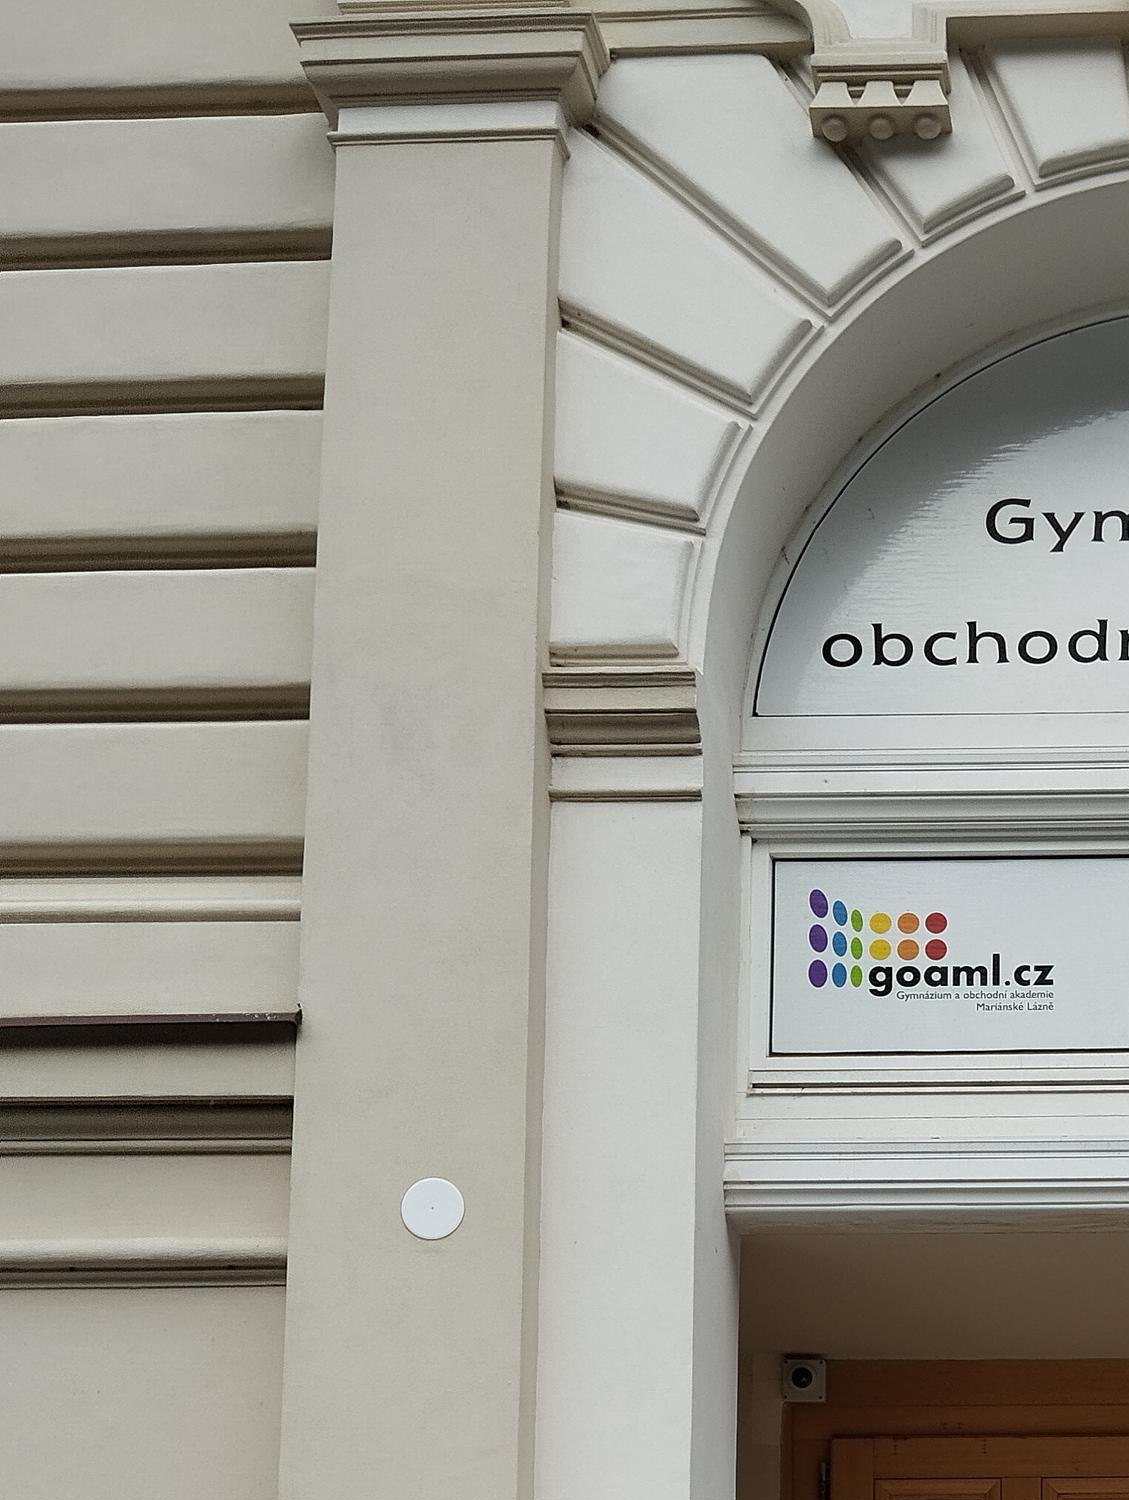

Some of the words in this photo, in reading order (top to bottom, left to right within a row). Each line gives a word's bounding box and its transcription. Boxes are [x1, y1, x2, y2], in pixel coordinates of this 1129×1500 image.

[868, 953, 1054, 997] goaml.cz
[896, 990, 952, 1002] Gymnázium
[963, 990, 1007, 999] obchodní
[1010, 990, 1054, 999] akademie
[976, 1001, 1023, 1011] Mariánské
[1027, 1002, 1054, 1011] Lázně
